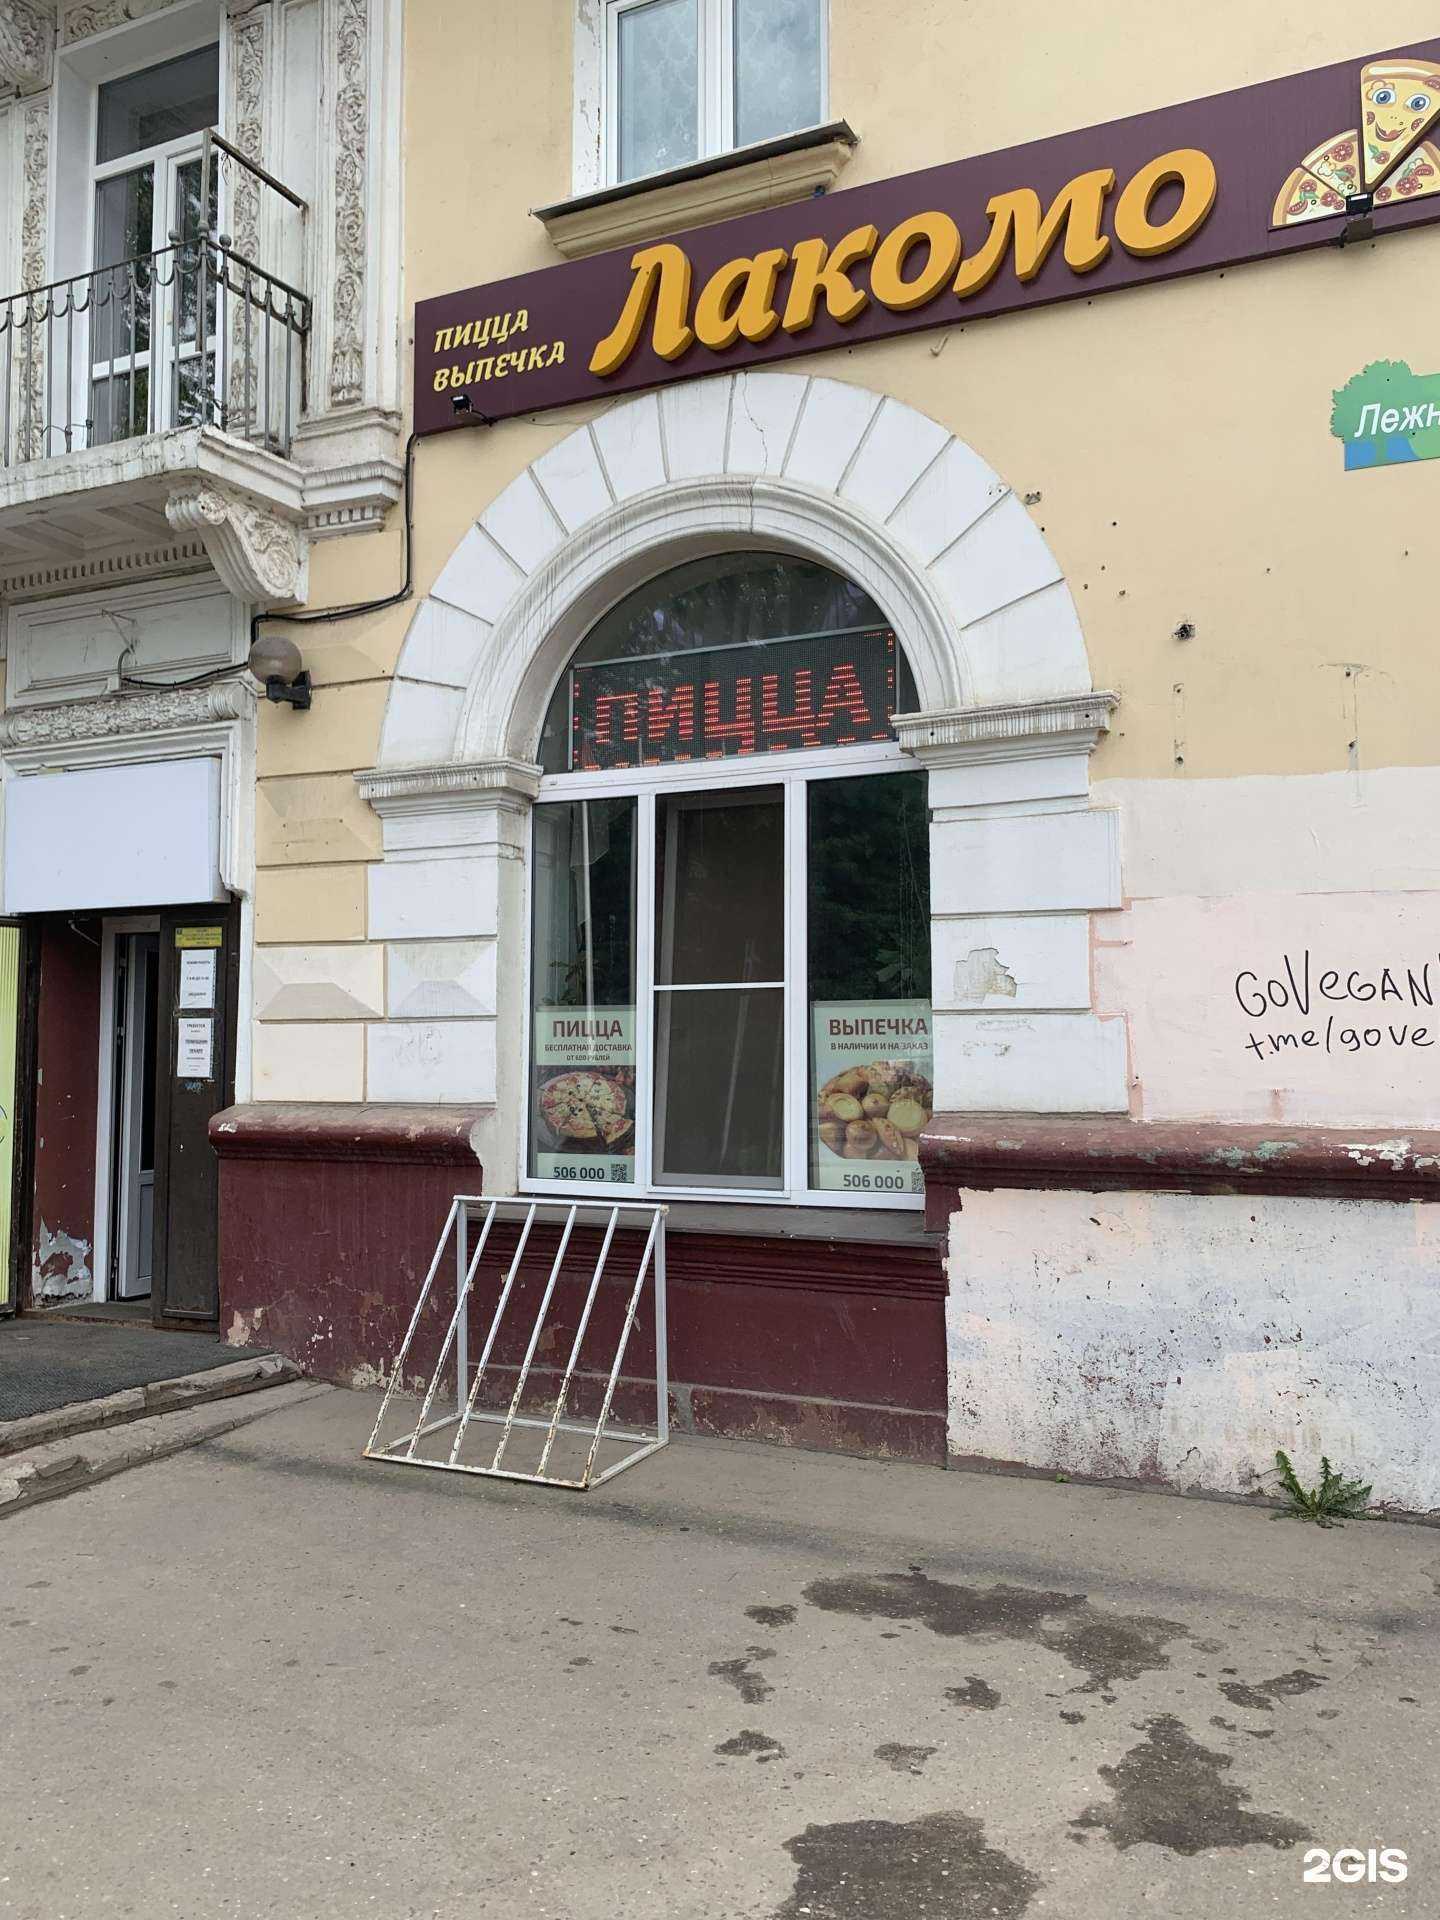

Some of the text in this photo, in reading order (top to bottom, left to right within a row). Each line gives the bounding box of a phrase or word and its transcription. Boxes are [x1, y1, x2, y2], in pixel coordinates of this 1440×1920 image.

[588, 148, 1217, 376] Лакомо
[433, 309, 528, 353] ПИЦЦА
[433, 340, 565, 392] ВЫПЕЧКА
[1354, 403, 1440, 438] Лежн
[595, 663, 871, 754] ПИЦЦА
[552, 1020, 623, 1040] ПИЦЦА
[829, 1018, 928, 1035] ВЫПЕЧКА
[830, 1042, 837, 1050] В
[838, 1042, 878, 1050] НАЛИЧИИ
[880, 1042, 886, 1050] И
[888, 1042, 900, 1050] НА
[553, 1166, 605, 1180] 506 000
[843, 1174, 904, 1189] 506 000
